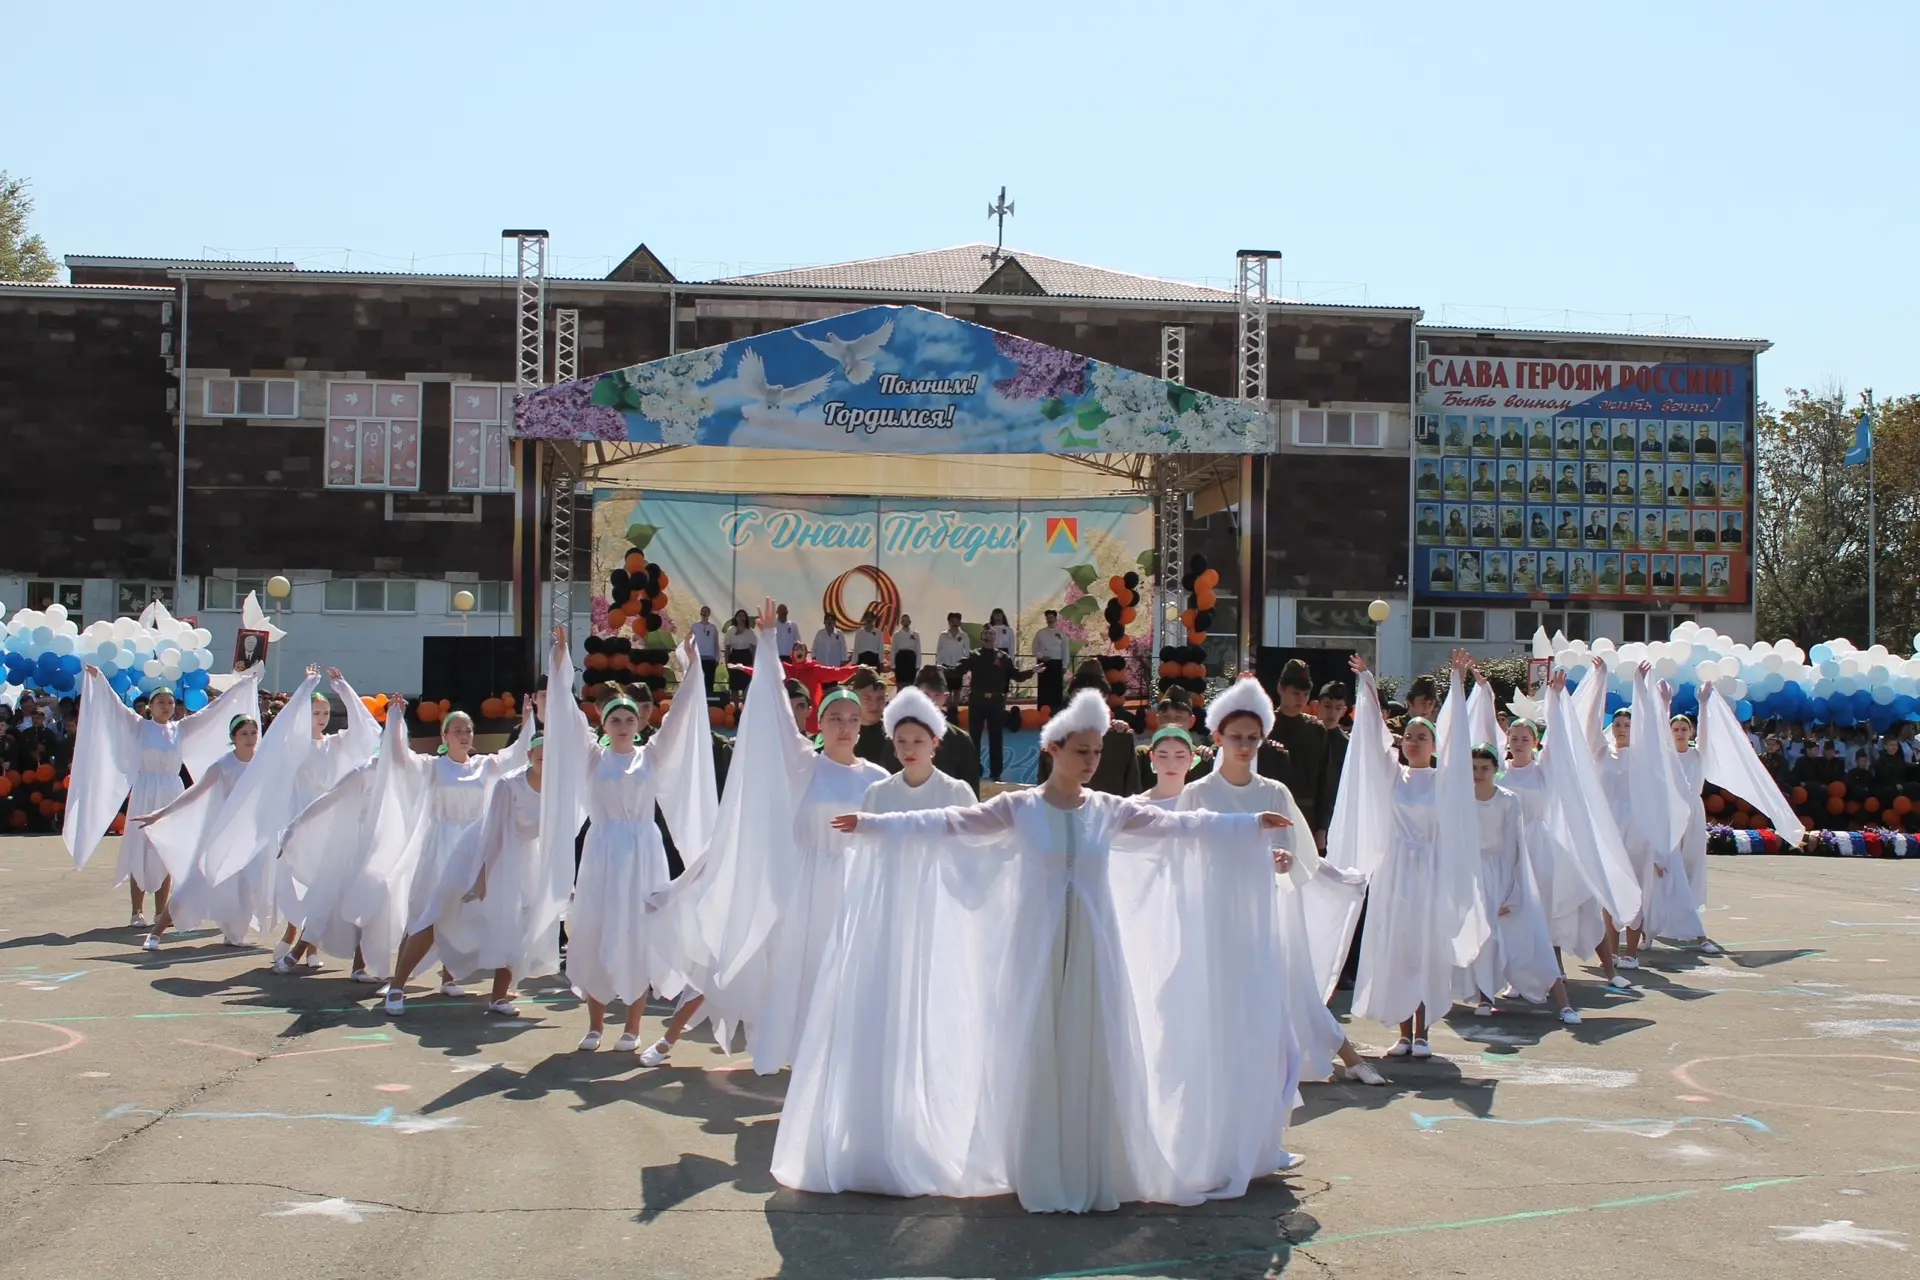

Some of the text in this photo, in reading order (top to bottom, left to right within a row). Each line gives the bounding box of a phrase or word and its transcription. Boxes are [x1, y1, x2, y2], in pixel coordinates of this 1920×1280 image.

[879, 373, 978, 395] Помним!
[1427, 358, 1735, 396] СЛАВА ГЕРОЯМ РОССИИ!
[823, 401, 956, 434] Гордимся!
[1442, 391, 1496, 408] Быть
[1503, 394, 1572, 410] воином
[1598, 398, 1652, 412] жить
[1660, 397, 1722, 413] вечно!
[721, 510, 758, 548] С
[884, 511, 1028, 564] Победы!
